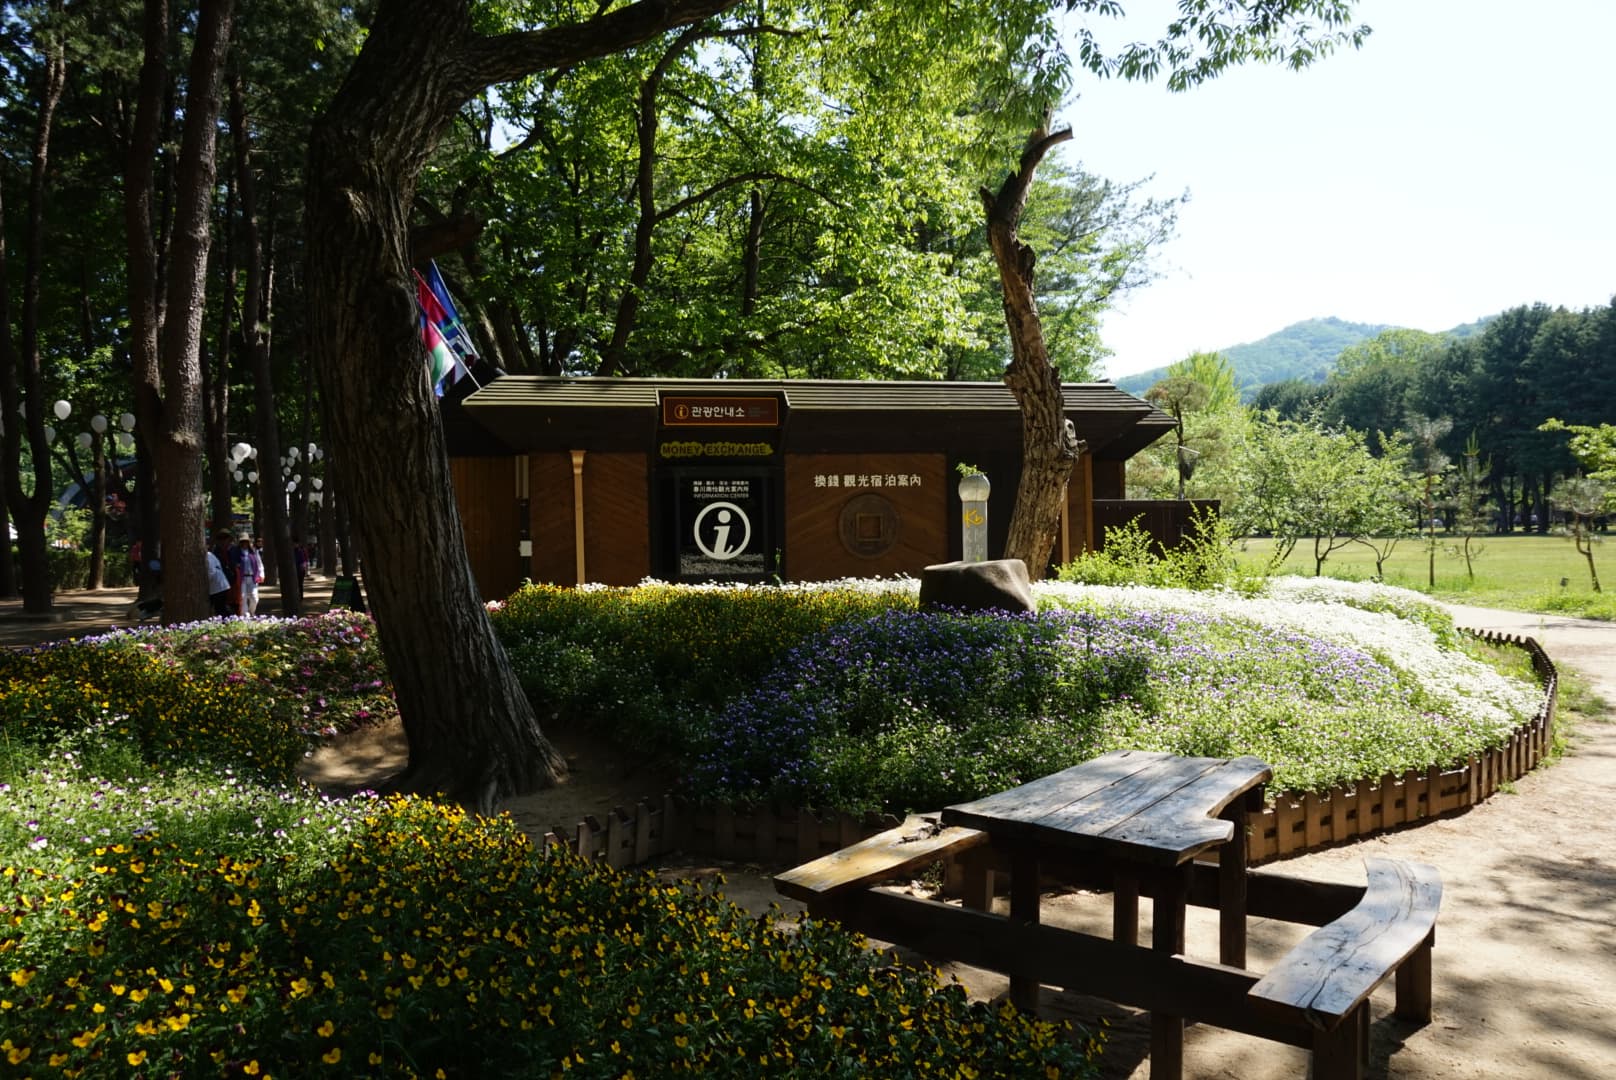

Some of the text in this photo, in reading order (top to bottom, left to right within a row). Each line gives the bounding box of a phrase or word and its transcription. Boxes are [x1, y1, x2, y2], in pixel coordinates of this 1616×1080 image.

[692, 406, 745, 418] 관광안내소
[661, 443, 768, 457] MONEY EXCHANGE
